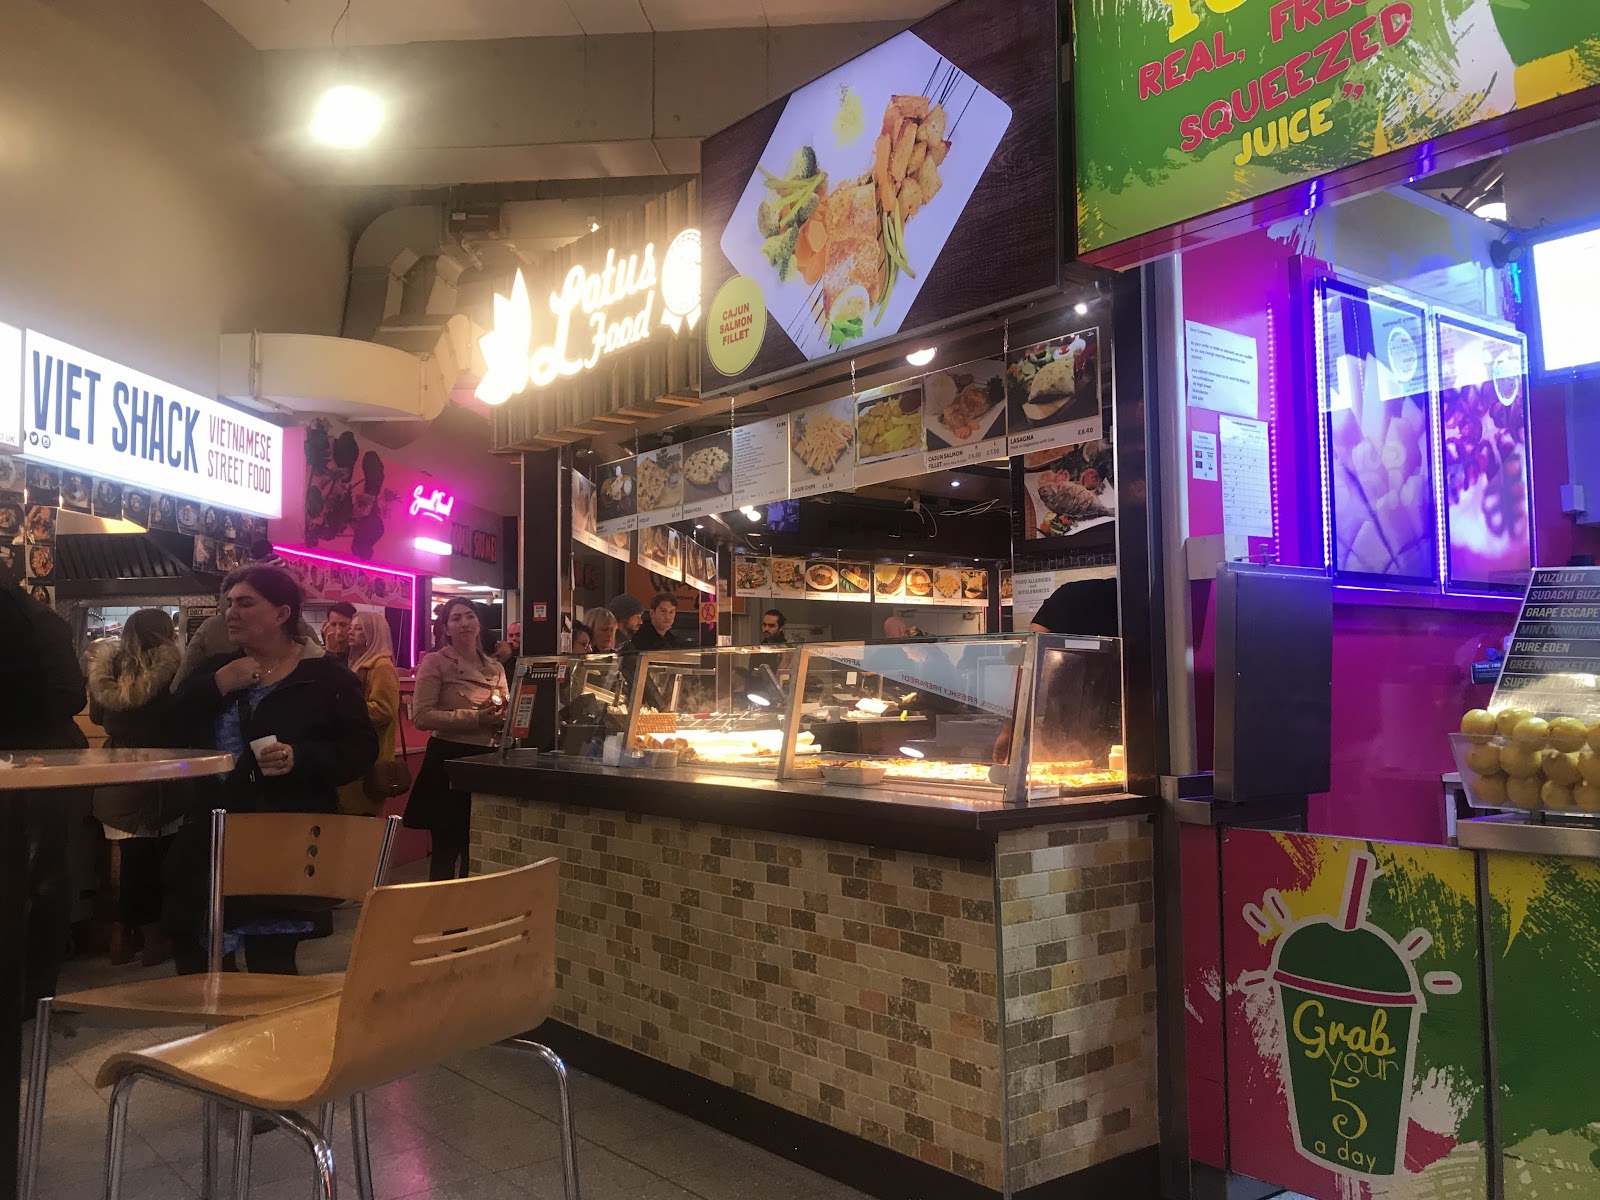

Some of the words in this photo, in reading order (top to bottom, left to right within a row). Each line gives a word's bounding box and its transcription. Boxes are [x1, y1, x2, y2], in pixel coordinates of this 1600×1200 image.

[1138, 31, 1246, 101] REAL,
[1269, 0, 1370, 43] FRE
[1178, 3, 1413, 152] SQUEEZED
[1235, 98, 1333, 166] JUICE
[719, 314, 753, 335] SALMON
[722, 302, 750, 321] CAJUN
[583, 290, 655, 369] Food
[722, 328, 750, 346] FILLET
[33, 350, 101, 445] VIET
[112, 381, 200, 474] SHACK
[209, 414, 271, 463] VIETNAMESE
[1010, 435, 1034, 445] LASAGNA
[1077, 427, 1094, 435] £6.40
[944, 450, 963, 459] SALMON
[207, 449, 245, 487] STREET
[247, 462, 271, 494] FOOD
[1537, 573, 1564, 583] YUZU
[1565, 572, 1587, 583] LIFT
[1531, 590, 1574, 600] SUDACHI
[1526, 607, 1559, 617] GRAPE
[1560, 607, 1600, 618] ESCAPE
[1520, 624, 1546, 635] MINT
[1514, 642, 1542, 652] PURE
[1542, 642, 1570, 653] EDEN
[1509, 660, 1541, 670] GREEN
[1543, 661, 1586, 671] ROCKET
[1292, 999, 1396, 1059] Grab
[1323, 1046, 1399, 1081] your
[1329, 1075, 1368, 1140] 5
[1314, 1140, 1326, 1154] a
[1337, 1141, 1377, 1174] day
